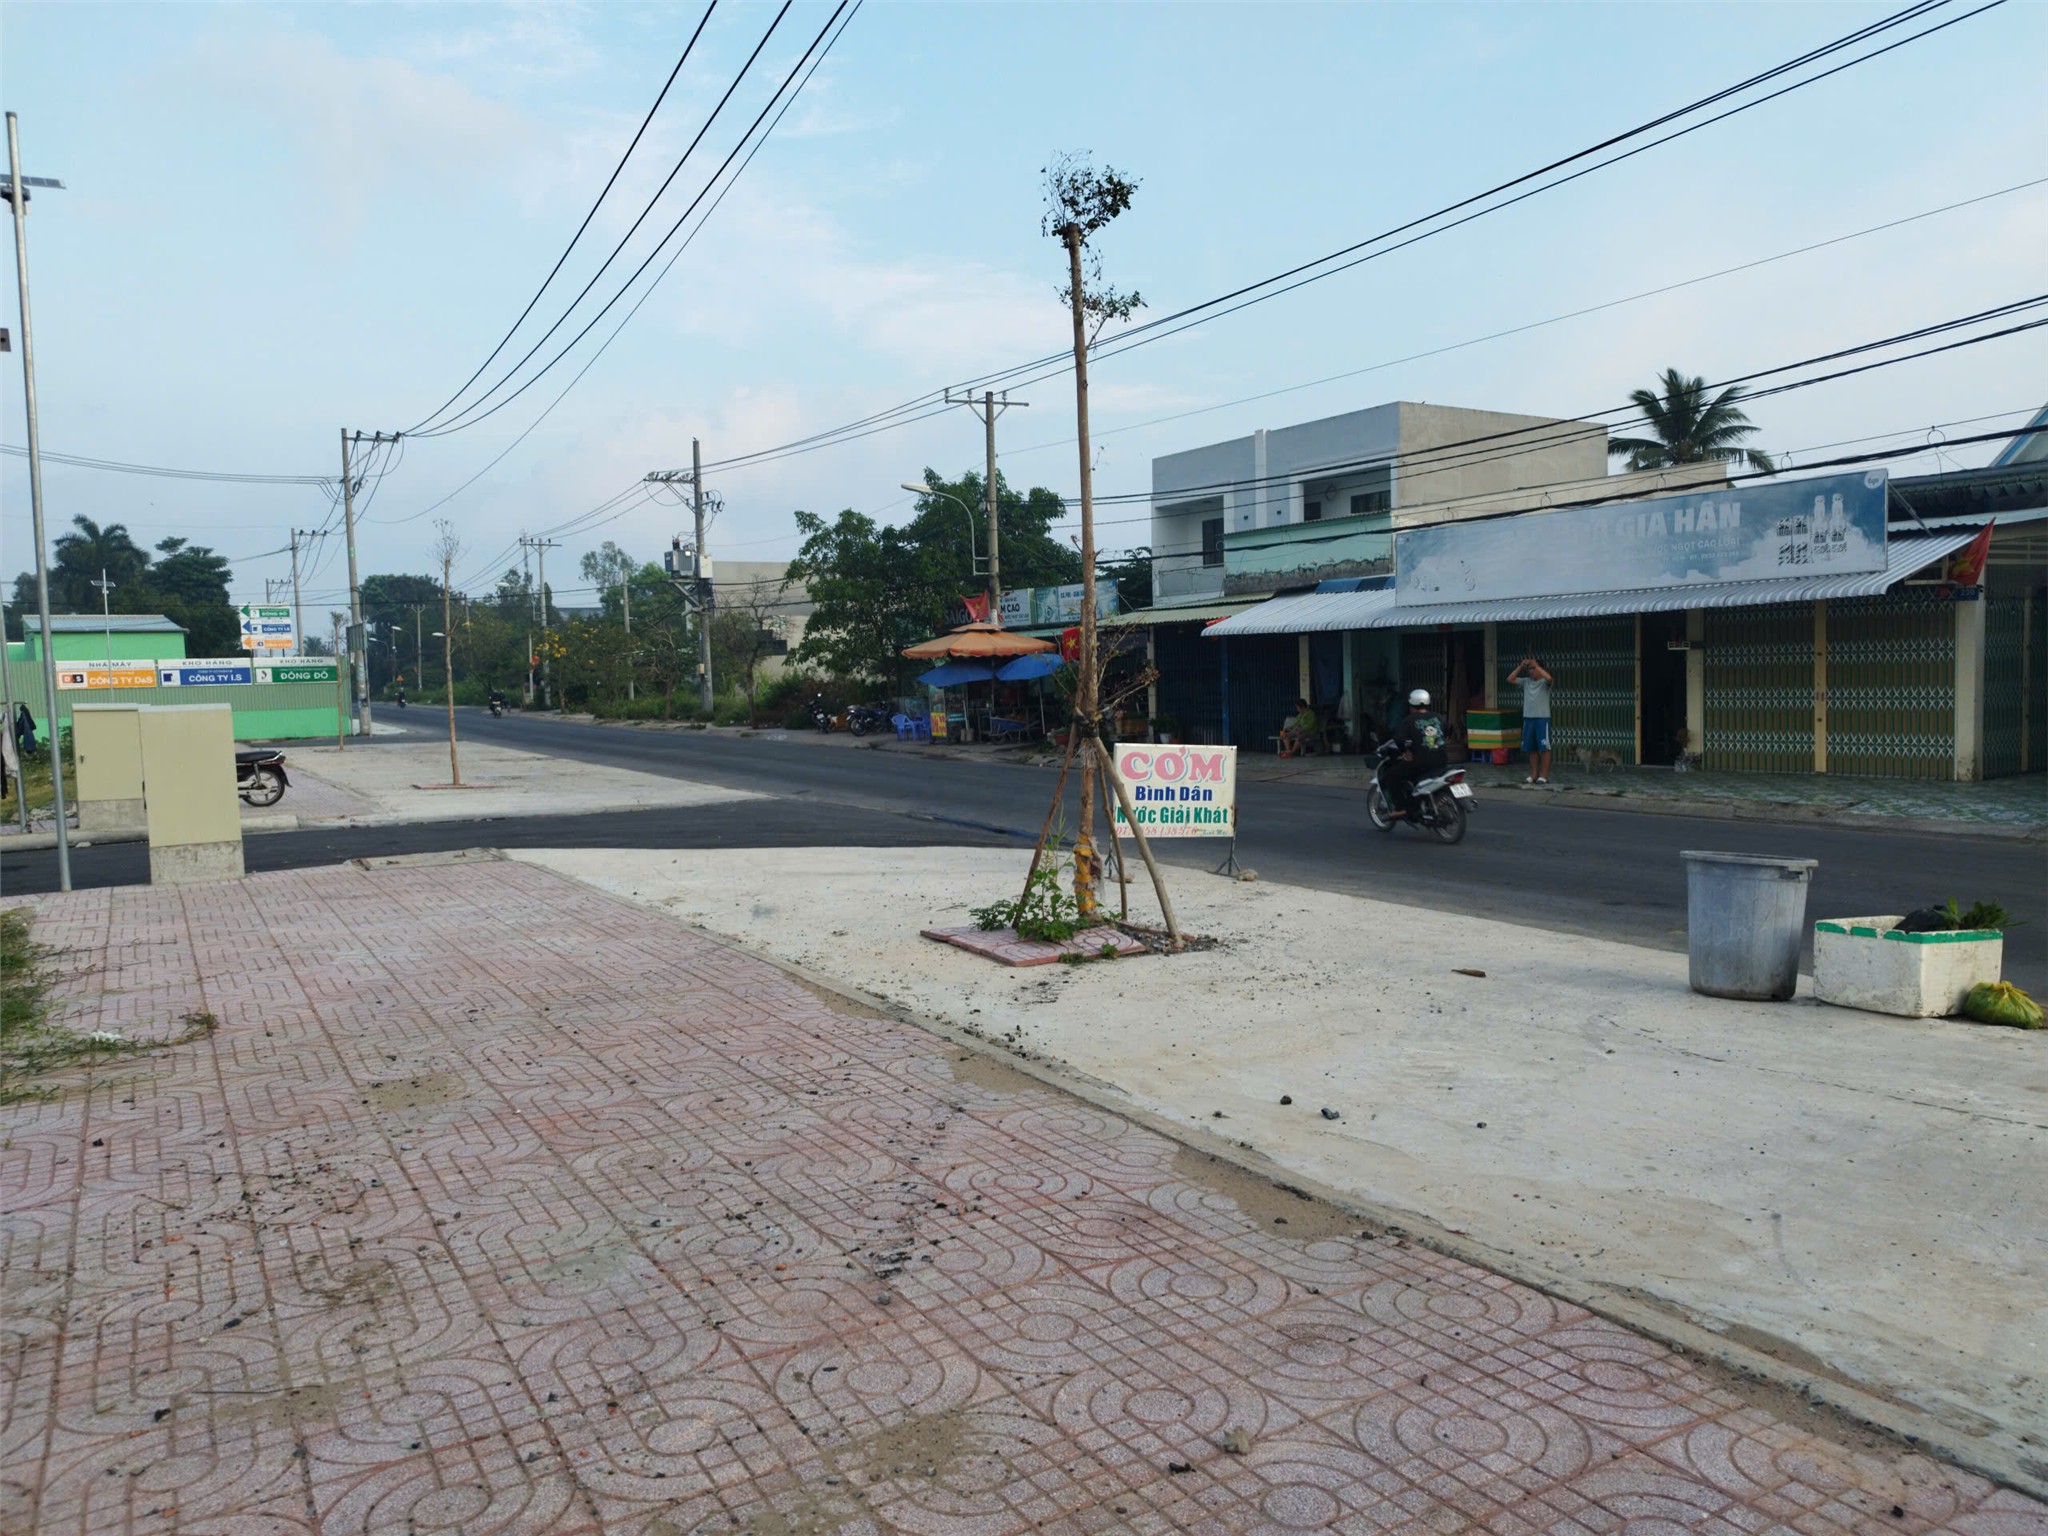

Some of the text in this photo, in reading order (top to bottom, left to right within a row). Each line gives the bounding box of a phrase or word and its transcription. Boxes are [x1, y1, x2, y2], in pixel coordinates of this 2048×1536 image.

[1617, 511, 1669, 540] GIA
[1674, 500, 1741, 533] HÂN
[943, 608, 973, 625] SAIGO
[88, 659, 132, 668] NHÀ MÁY
[208, 658, 233, 666] HÀNG
[300, 657, 324, 665] HÀNG
[89, 674, 117, 686] CÔNG
[121, 675, 133, 685] TY
[188, 671, 216, 683] CÔNG
[217, 673, 229, 682] TY
[281, 669, 311, 680] ĐÔNG
[313, 669, 329, 680] ĐÔ
[1120, 746, 1225, 782] CƠM
[1135, 785, 1213, 801] Bình Dân
[1117, 804, 1228, 824] Nớc Giải Khát
